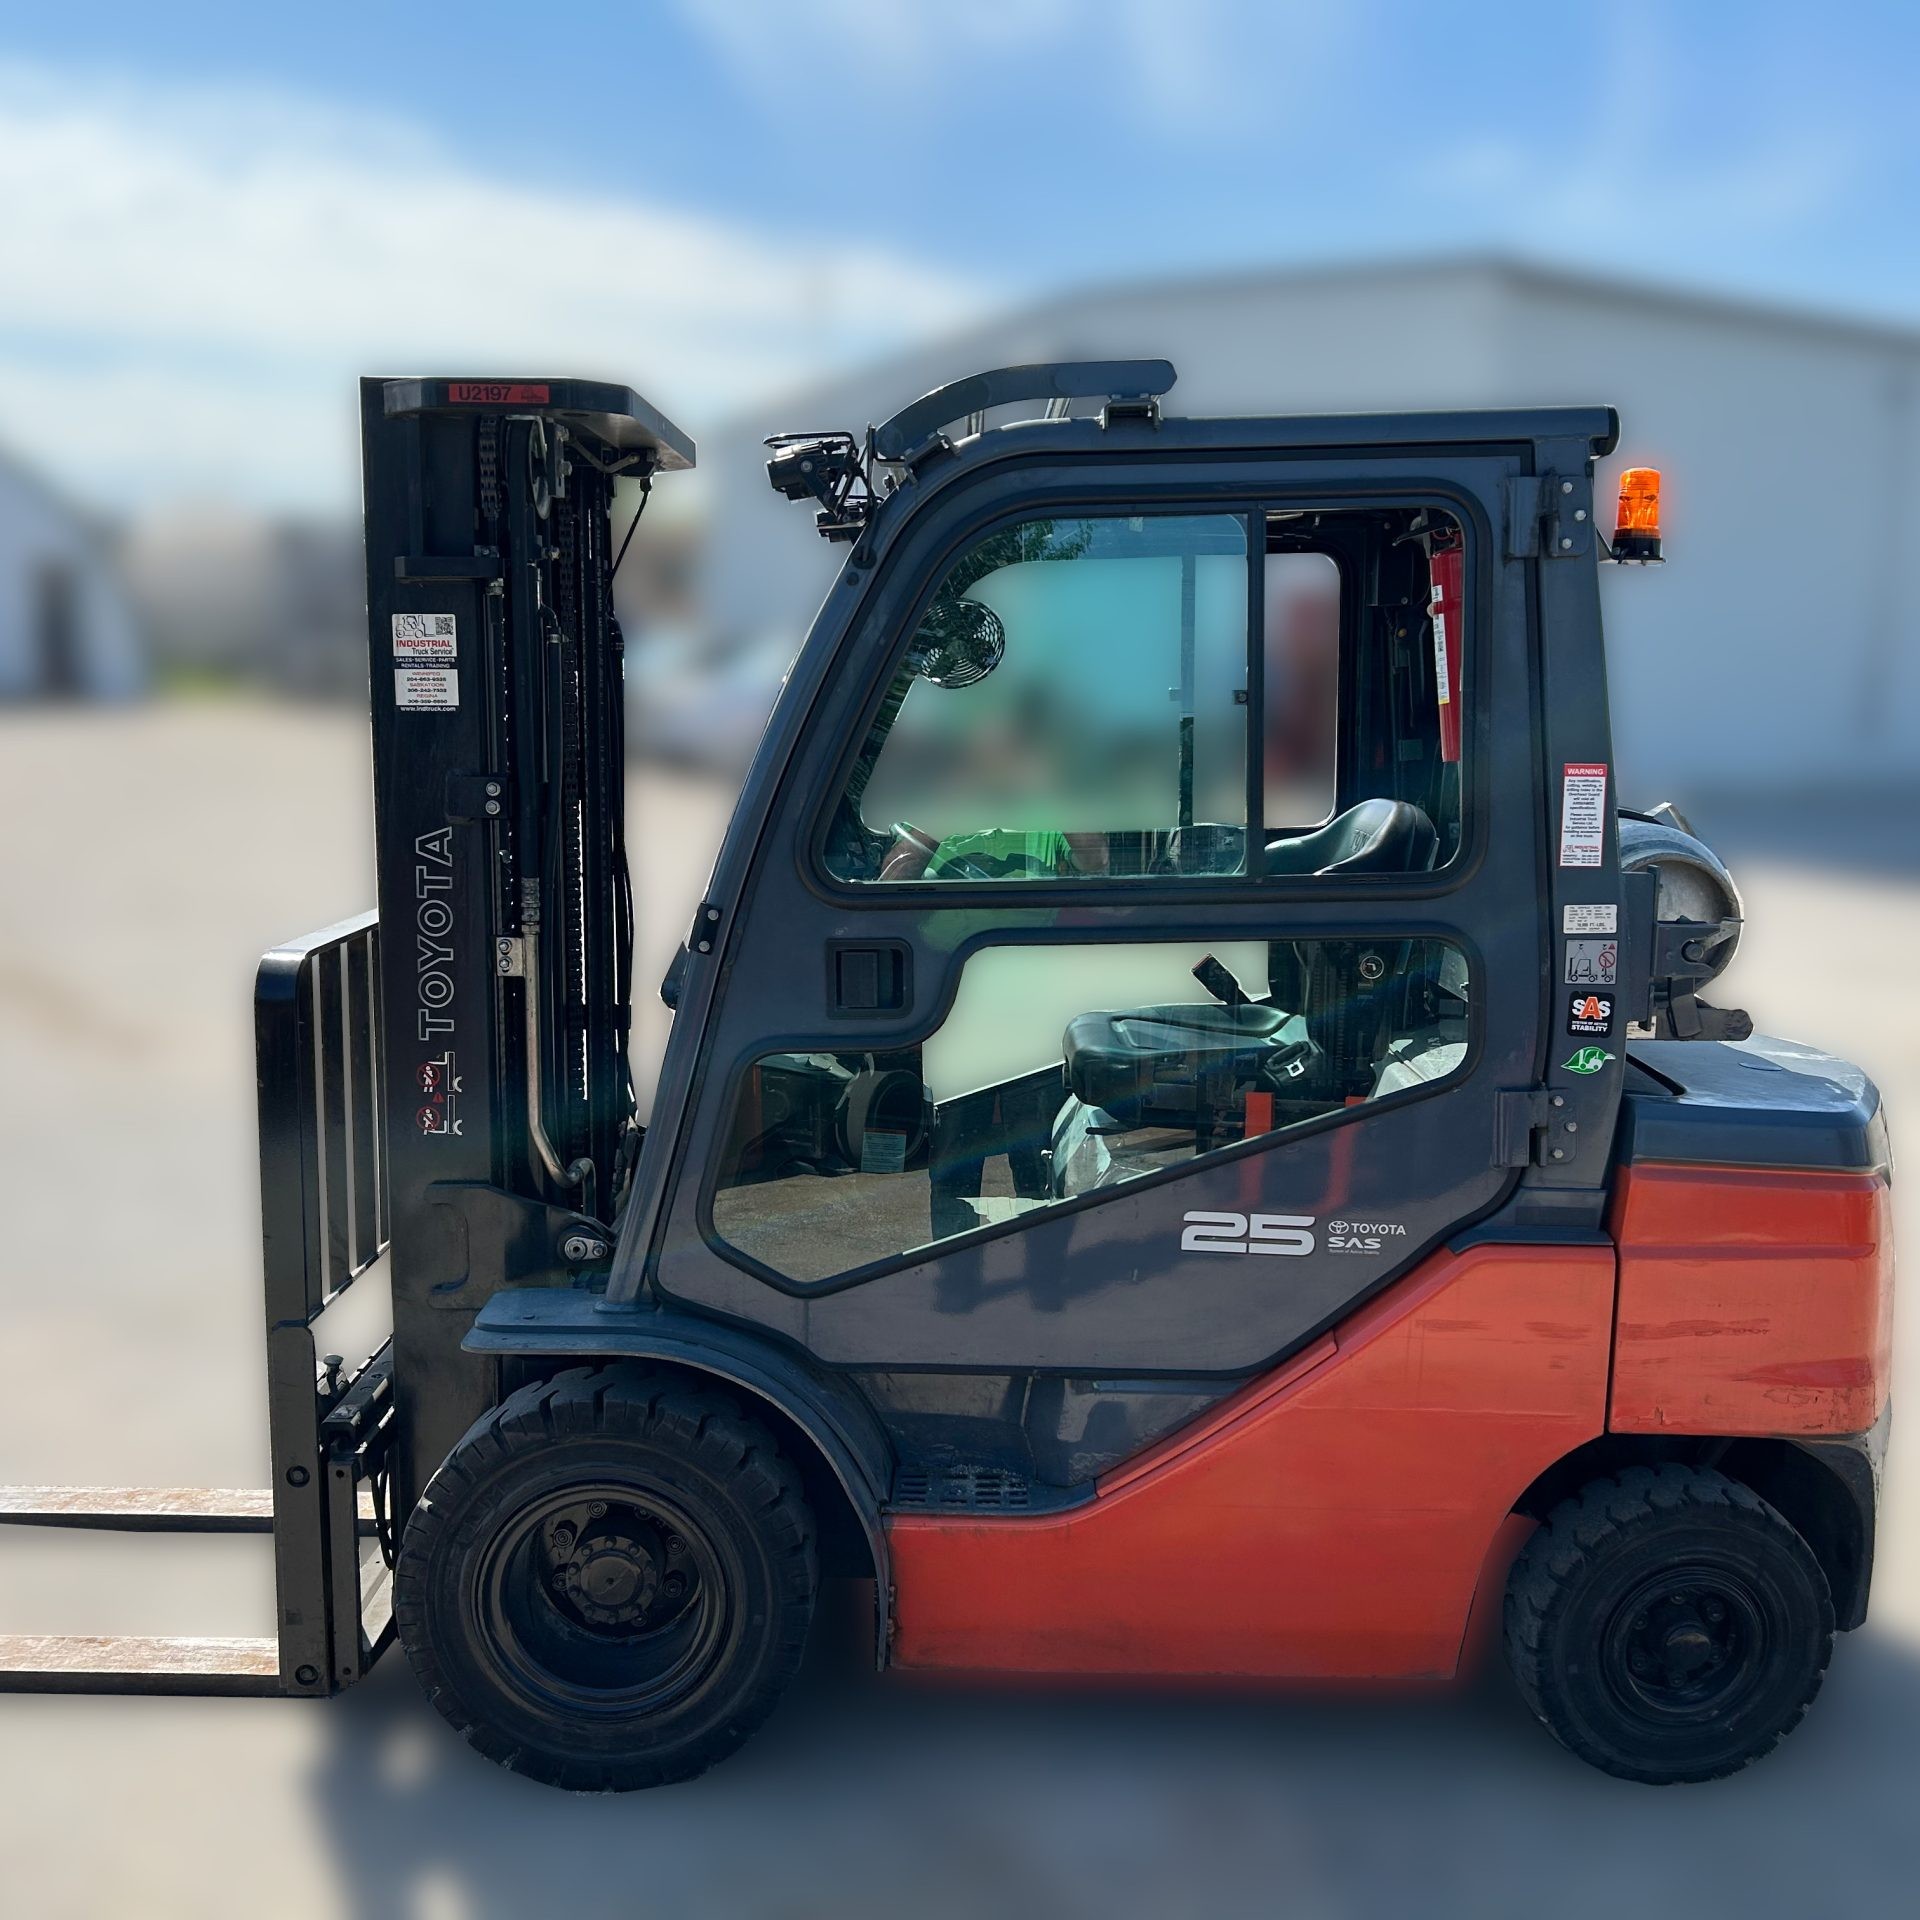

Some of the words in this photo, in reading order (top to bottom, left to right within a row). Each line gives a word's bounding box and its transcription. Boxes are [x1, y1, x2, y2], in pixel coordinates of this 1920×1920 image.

[458, 384, 512, 401] U2197
[416, 826, 455, 1041] TOYOTA
[1571, 996, 1611, 1020] SAS
[1181, 1211, 1315, 1256] 25
[1351, 1222, 1407, 1236] TOYOTA
[1327, 1236, 1382, 1250] SAS
